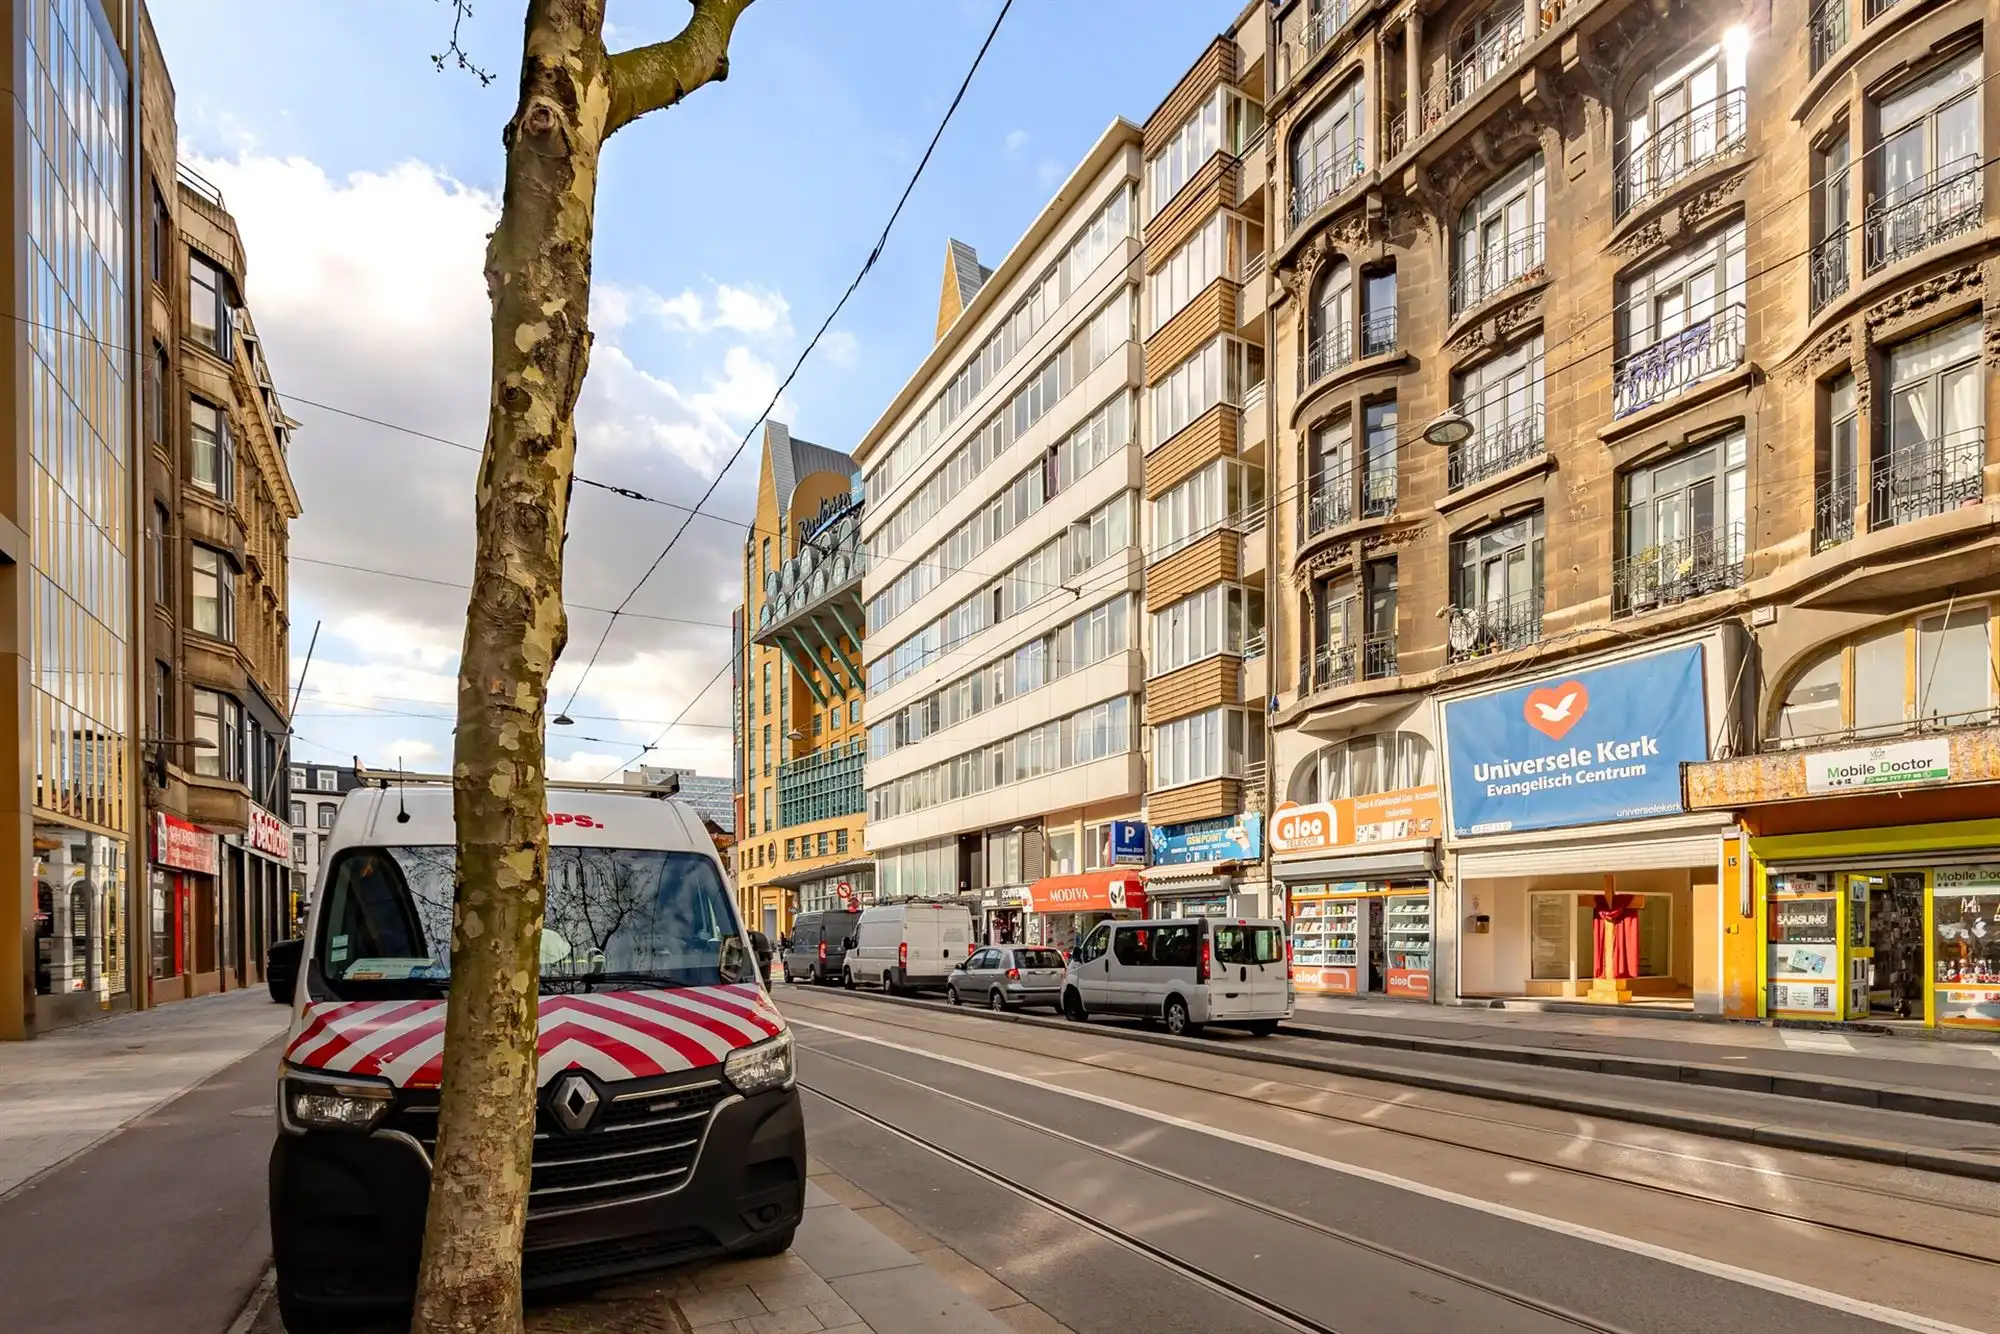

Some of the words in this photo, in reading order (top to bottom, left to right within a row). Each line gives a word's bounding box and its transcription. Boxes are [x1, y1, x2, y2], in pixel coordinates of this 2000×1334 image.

[1474, 747, 1592, 782] Universele
[1597, 735, 1660, 763] Kerk
[1827, 764, 1876, 779] Mobile
[1880, 758, 1933, 773] Doctor
[1487, 773, 1573, 797] Evangelisch
[1575, 763, 1647, 784] Centrum
[1616, 803, 1682, 817] universelekerk
[1185, 824, 1202, 834] NEW
[1202, 820, 1229, 833] WORLD
[1283, 816, 1322, 839] aloo
[1125, 826, 1135, 843] P
[1287, 837, 1318, 847] TELECOM
[1728, 857, 1737, 867] 15
[1936, 871, 1976, 881] Mobile
[1050, 887, 1089, 901] MODIVA
[1777, 913, 1827, 925] SAMSUNG
